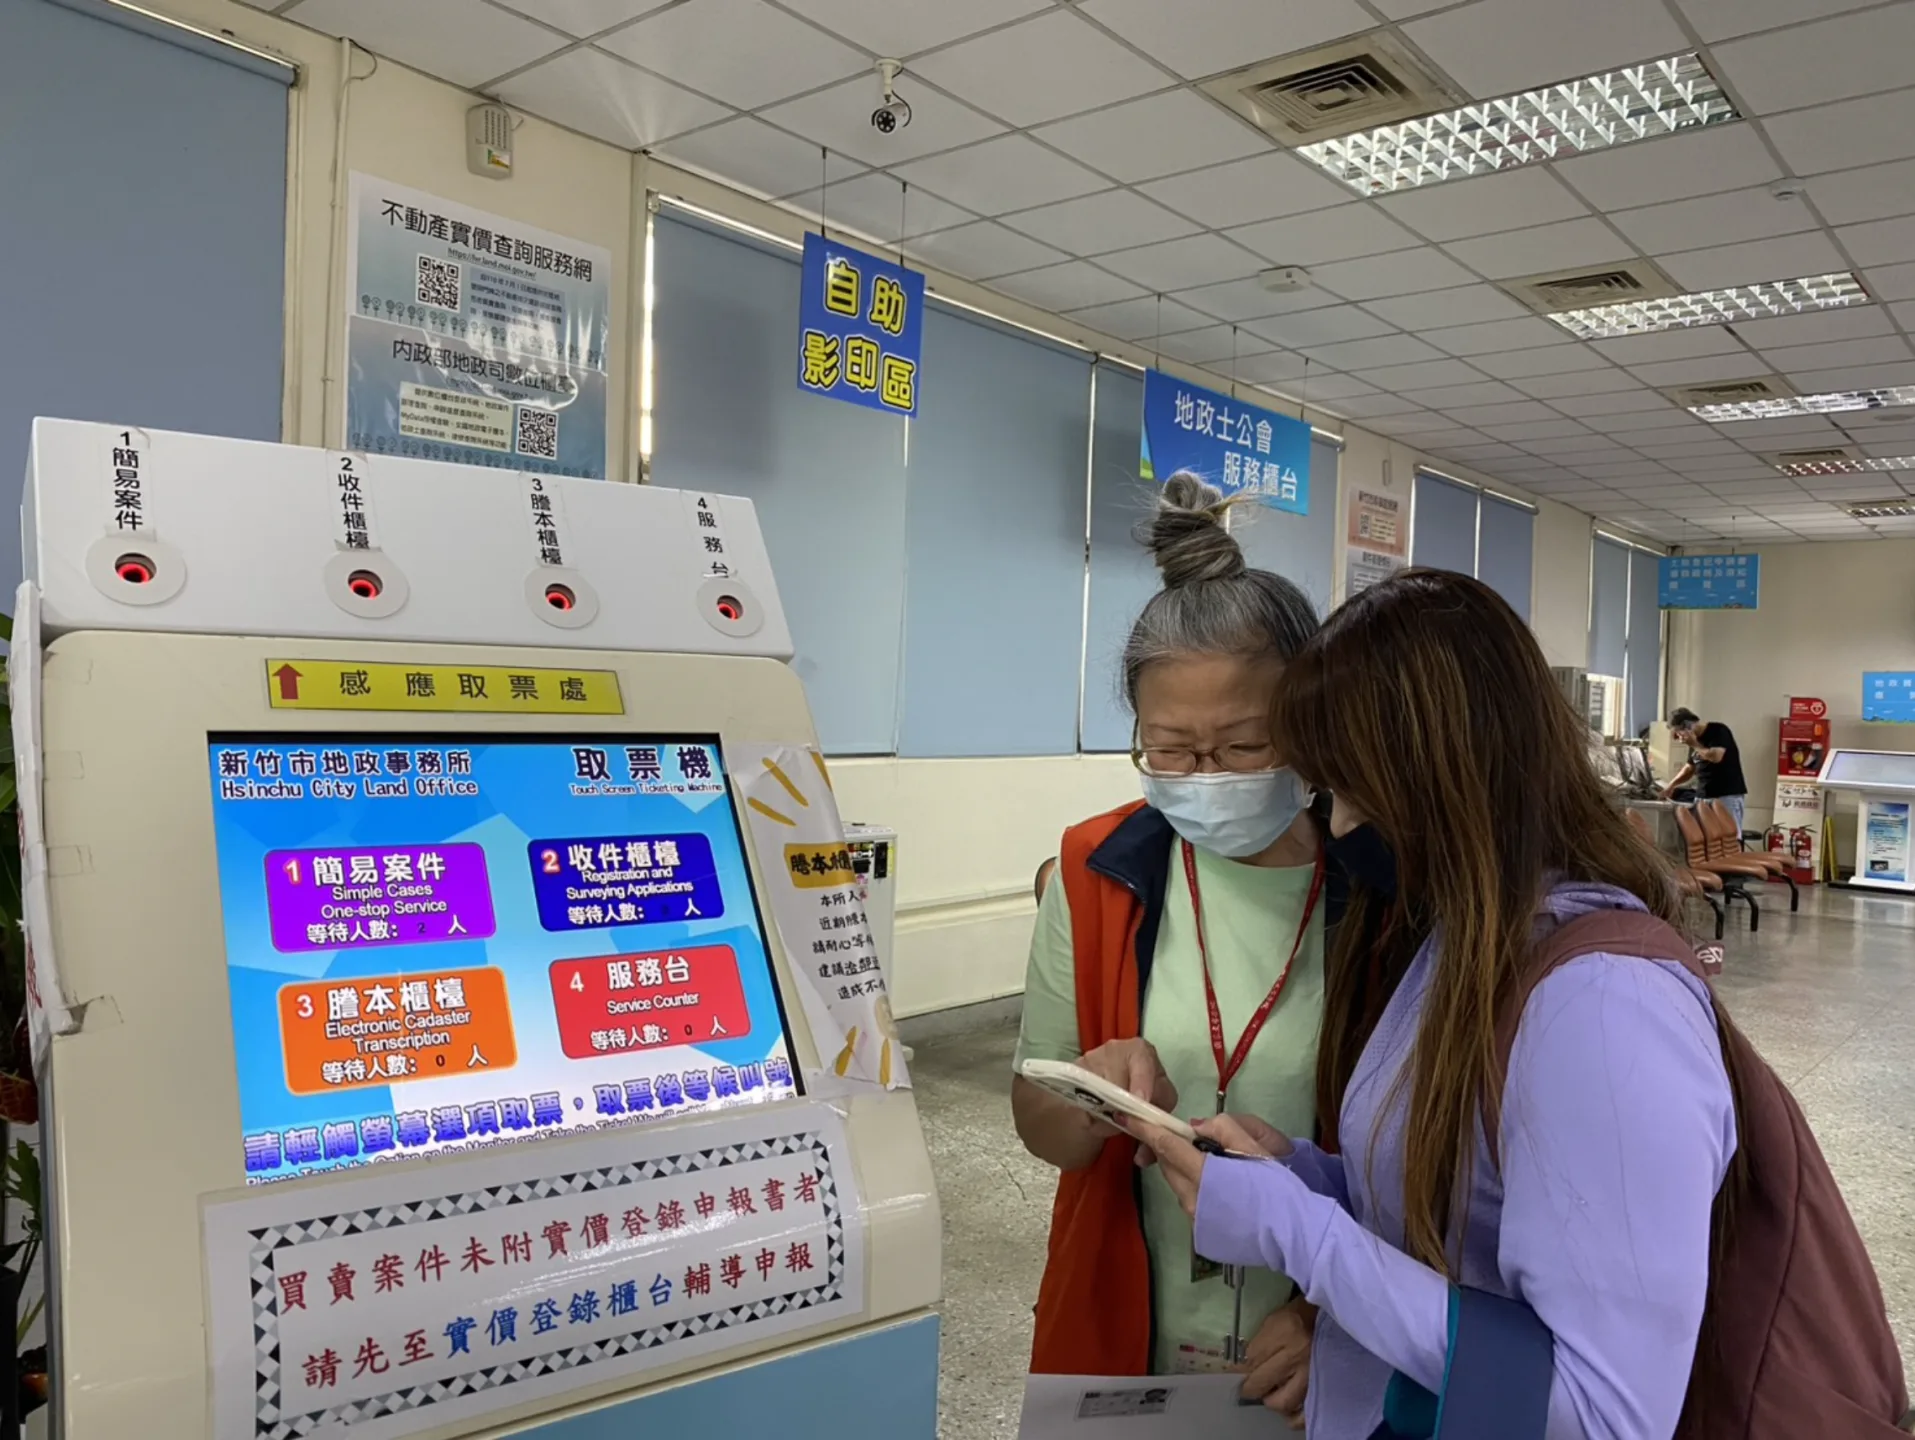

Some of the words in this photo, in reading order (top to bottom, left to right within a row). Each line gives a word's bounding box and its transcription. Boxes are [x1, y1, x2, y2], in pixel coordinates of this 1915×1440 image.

[381, 198, 592, 282] 不動產實價查詢服務網
[825, 258, 906, 335] 自助
[802, 329, 916, 411] 影印區
[1174, 390, 1273, 454] 地政士公會
[1223, 451, 1298, 501] 服務櫃台
[340, 669, 587, 702] 感應取票處
[220, 750, 470, 776] 新竹市地政事務所
[572, 746, 711, 780] 取票機
[222, 779, 302, 798] Hsinchu
[311, 779, 354, 798] City
[365, 779, 408, 795] Land
[416, 778, 477, 794] Office
[570, 784, 598, 794] Touch
[602, 784, 634, 794] Screen
[638, 783, 684, 793] Ticketing
[687, 782, 722, 791] Machine
[286, 860, 299, 881] 1
[312, 852, 446, 885] 簡易案件
[541, 850, 560, 872] 2
[582, 869, 650, 884] Registration
[652, 867, 673, 878] and
[332, 885, 382, 901] Simple
[387, 883, 433, 898] Cases
[566, 886, 625, 902] Surveying
[627, 880, 693, 898] Applications
[321, 901, 389, 919] One-stop
[394, 899, 447, 914] Service
[685, 898, 701, 917] 人
[417, 922, 426, 934] 2
[448, 915, 467, 935] 人
[570, 971, 585, 992] 4
[607, 955, 690, 990] 服務台
[297, 995, 313, 1017] 3
[607, 996, 651, 1014] Service
[653, 992, 699, 1008] Counter
[325, 1018, 401, 1039] Electronic
[405, 1010, 471, 1029] Cadaster
[685, 1024, 693, 1036] 0
[710, 1016, 727, 1036] 人
[353, 1031, 450, 1053] Transcription
[436, 1055, 445, 1067] 0
[468, 1045, 488, 1067] 人
[278, 1172, 819, 1315] 買賣案件未附實價登錄申報書者
[302, 1242, 814, 1388] 請先至實價登錄櫃台輔導申報
